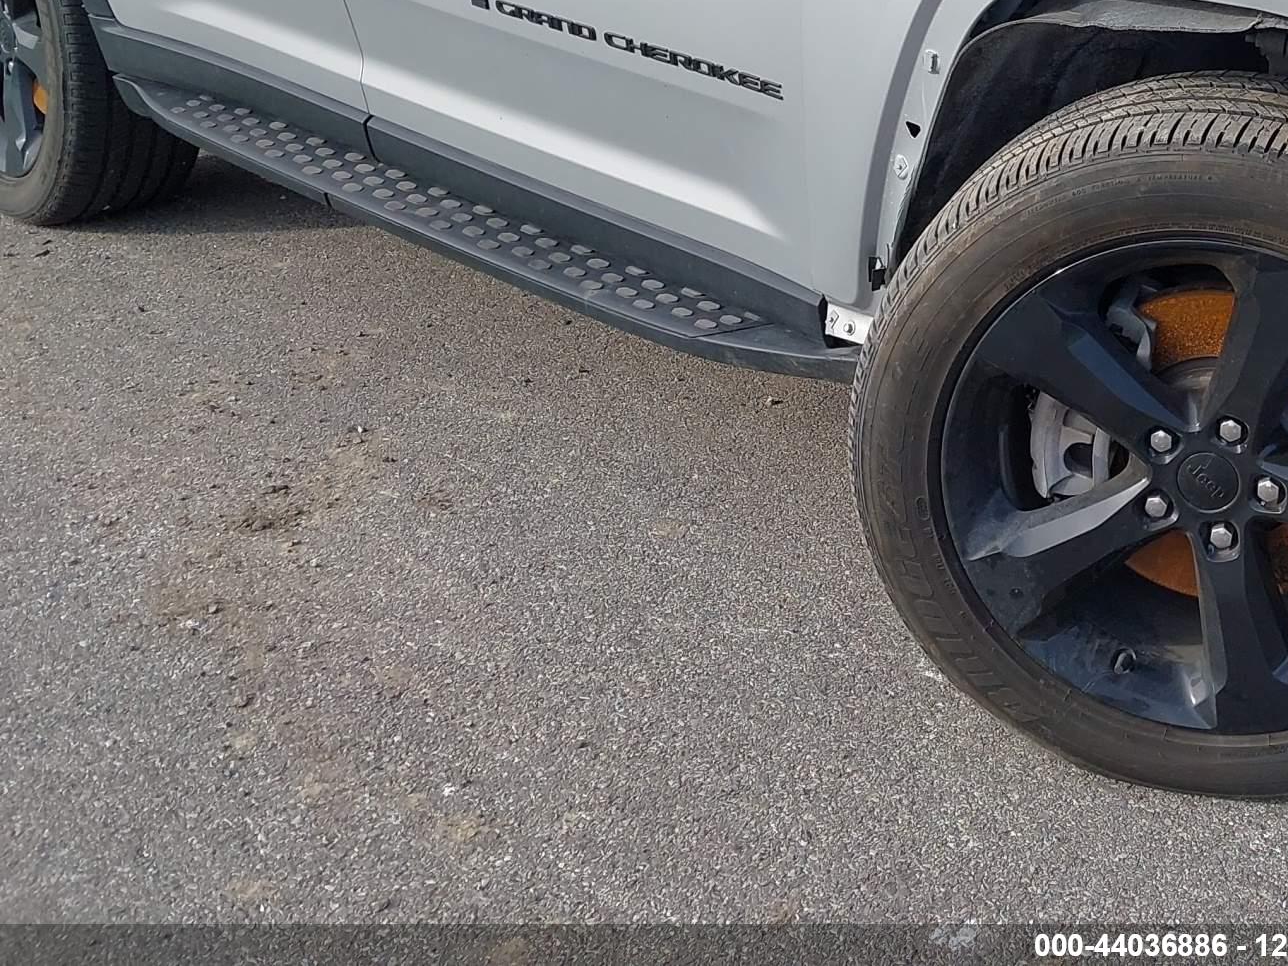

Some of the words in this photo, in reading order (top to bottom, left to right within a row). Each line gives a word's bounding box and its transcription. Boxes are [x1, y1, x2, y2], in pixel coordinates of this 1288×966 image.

[495, 0, 597, 41] GRAND
[603, 31, 785, 101] CHEROKEE
[1187, 463, 1226, 500] Jeep
